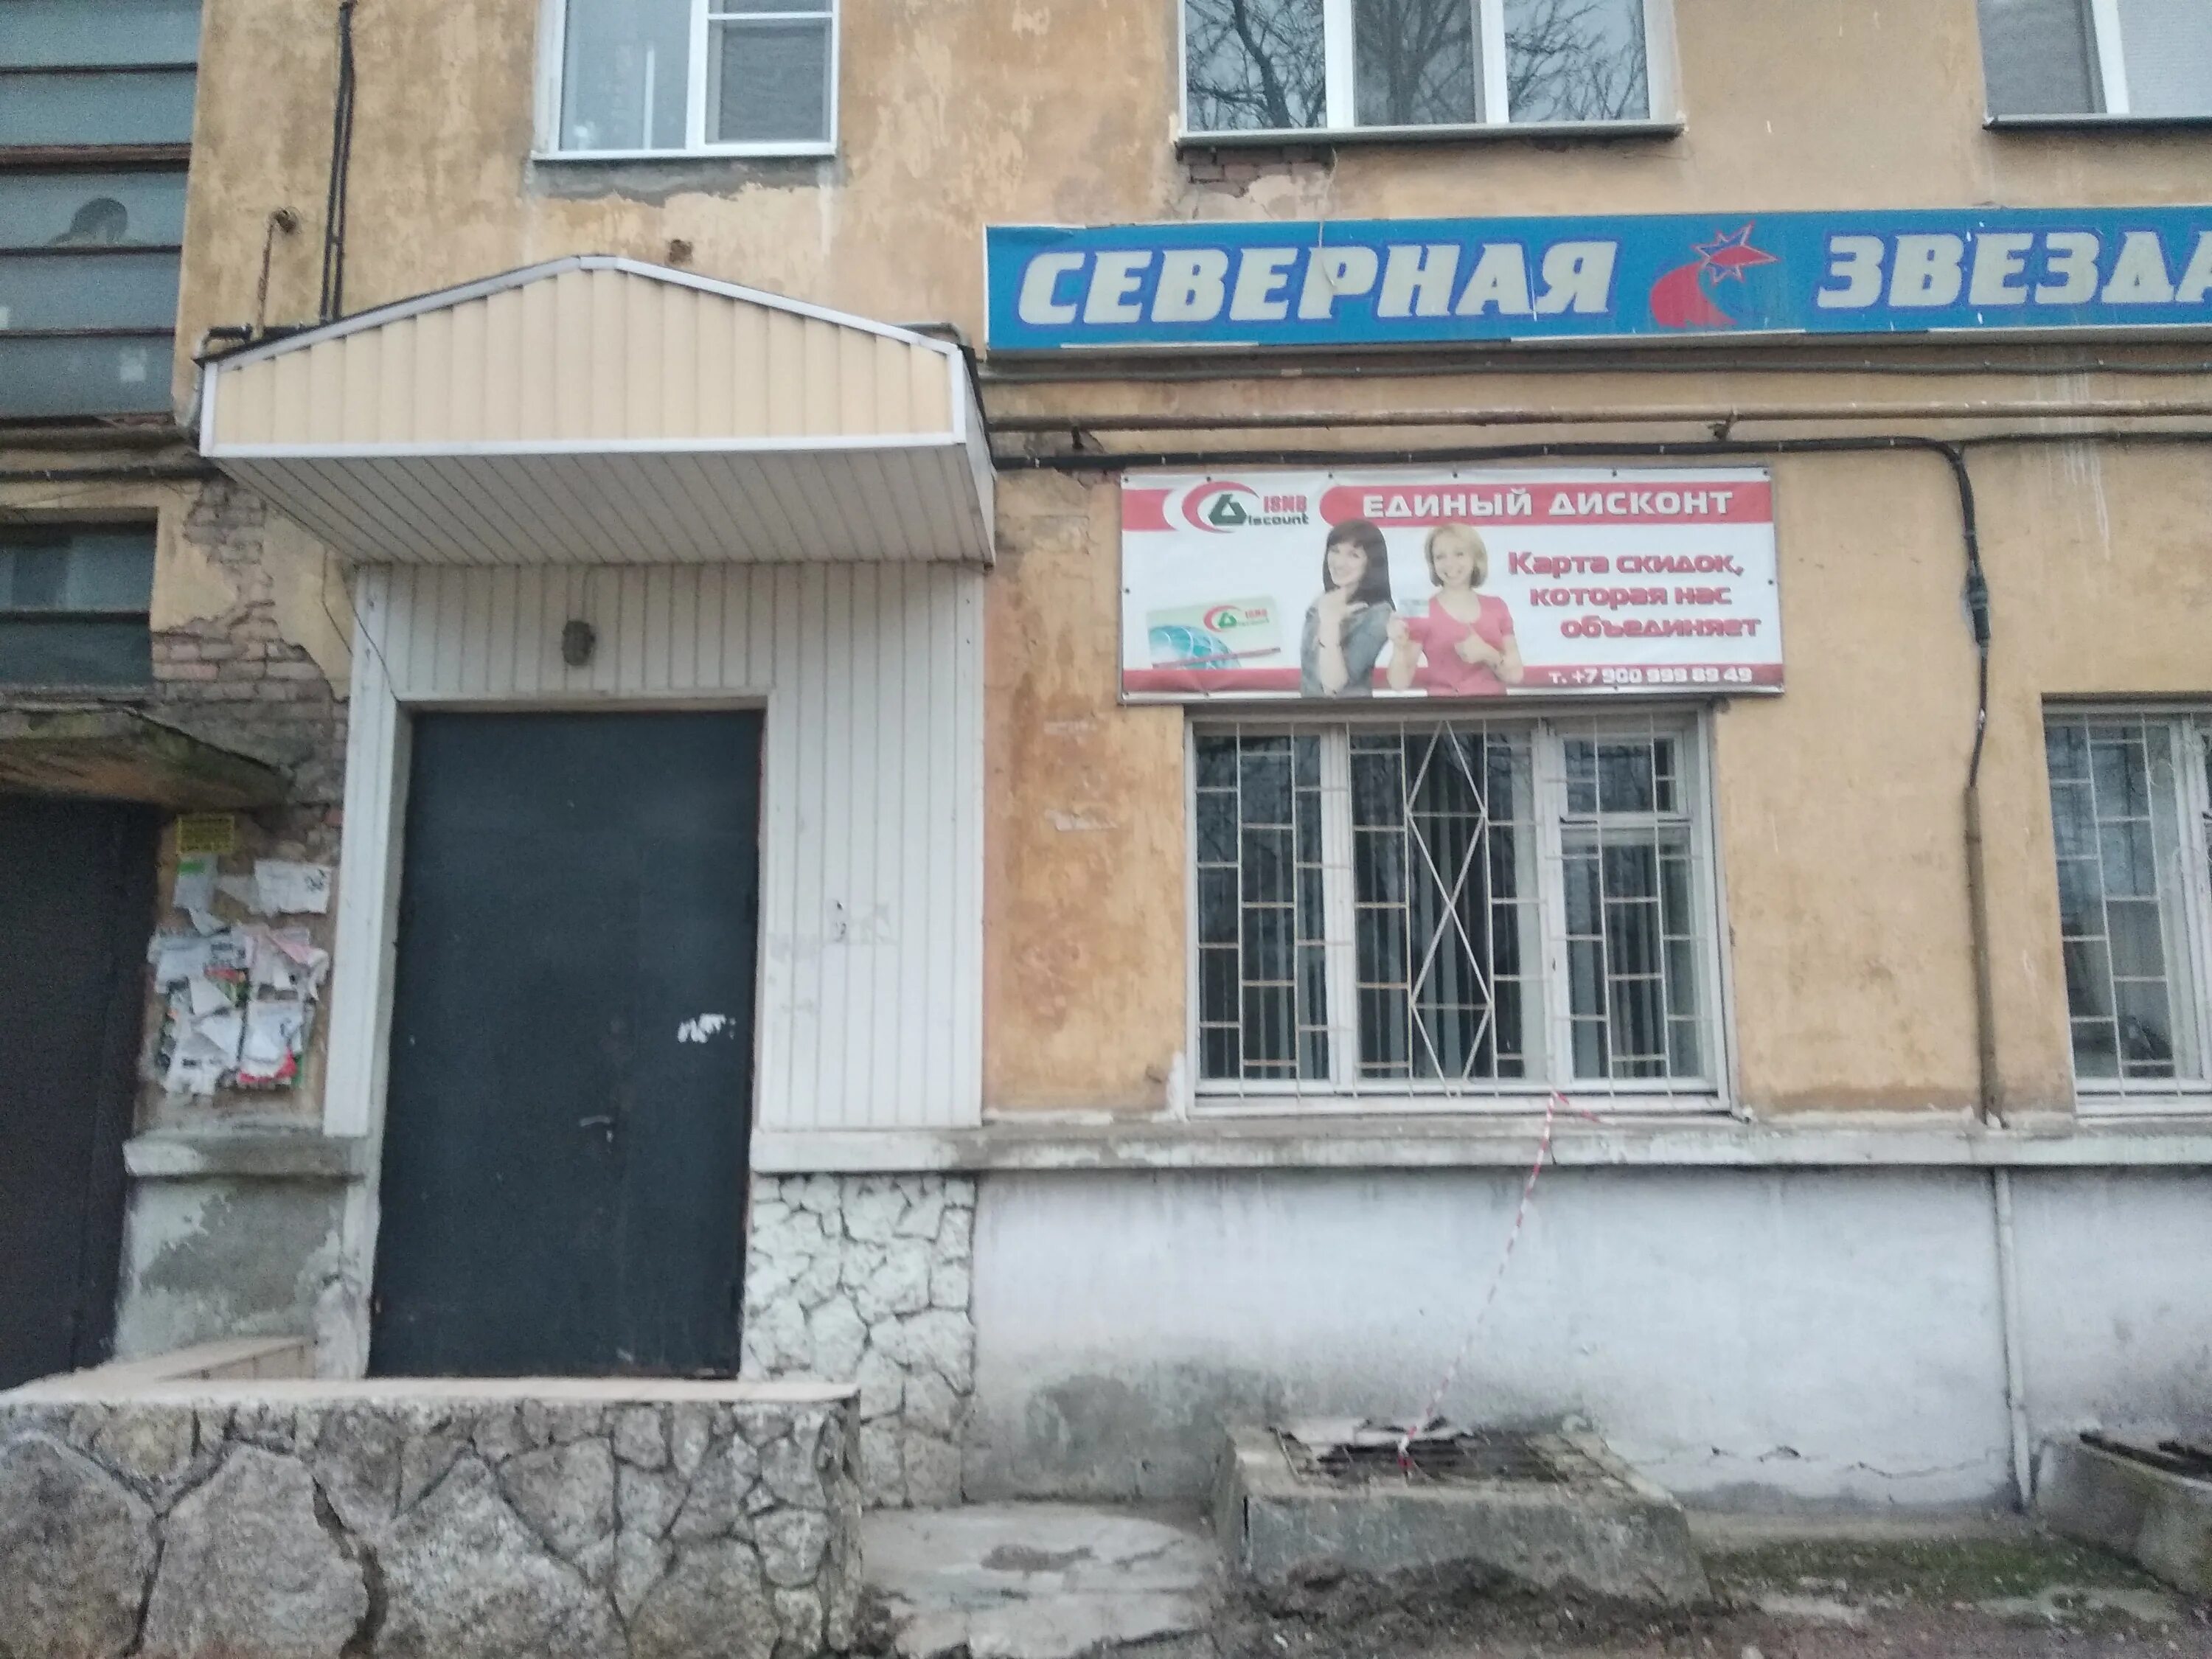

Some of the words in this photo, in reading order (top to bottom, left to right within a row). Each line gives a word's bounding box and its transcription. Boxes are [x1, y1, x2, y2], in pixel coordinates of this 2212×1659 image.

[1019, 241, 1616, 324] СЕВЕРНАЯ
[1363, 488, 1531, 517] ЕДИНЫЙ
[1549, 491, 1733, 515] ДИСКОНТ
[1508, 552, 1610, 578] Карта
[1616, 555, 1745, 576] скидок,
[1530, 587, 1667, 610] которая
[1674, 587, 1732, 605] нас
[1560, 615, 1761, 639] объединяет
[1571, 667, 1598, 684] +7
